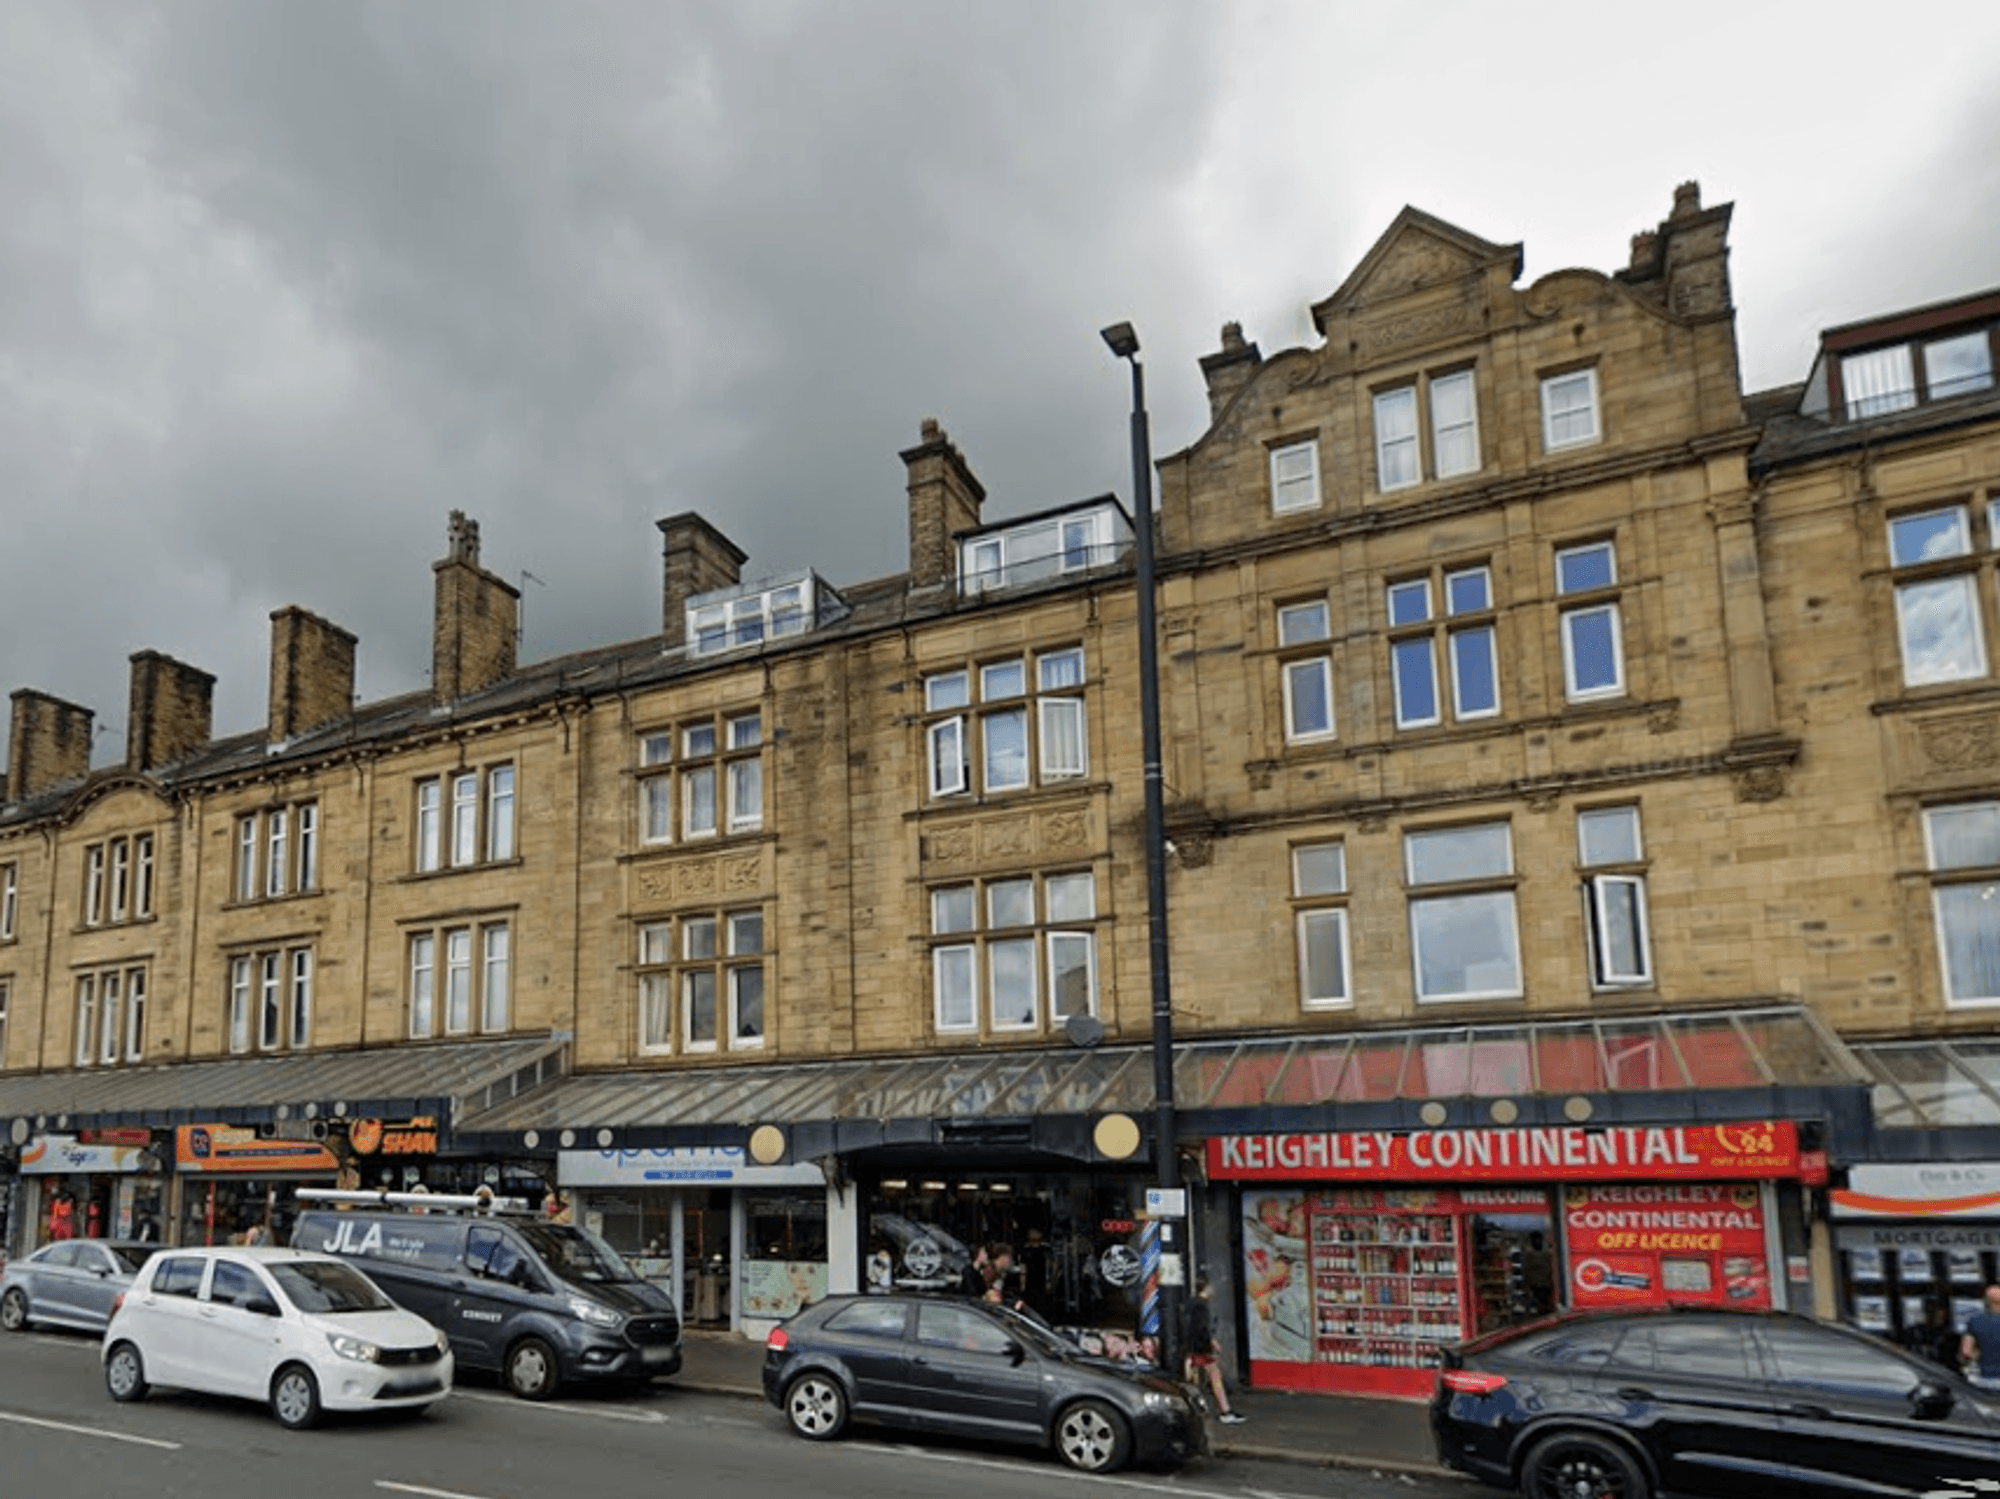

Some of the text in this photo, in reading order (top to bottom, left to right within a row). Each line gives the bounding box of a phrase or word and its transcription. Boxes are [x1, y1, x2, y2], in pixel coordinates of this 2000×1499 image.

[1221, 1126, 1699, 1168] KEIGHLEY CONTINENTAL
[1459, 1188, 1546, 1204] WELCOME
[1591, 1186, 1723, 1203] KEIGHLEY
[1569, 1210, 1761, 1229] CONTINENTAL
[322, 1221, 382, 1254] JLA
[1598, 1232, 1723, 1250] OFF LICENCE
